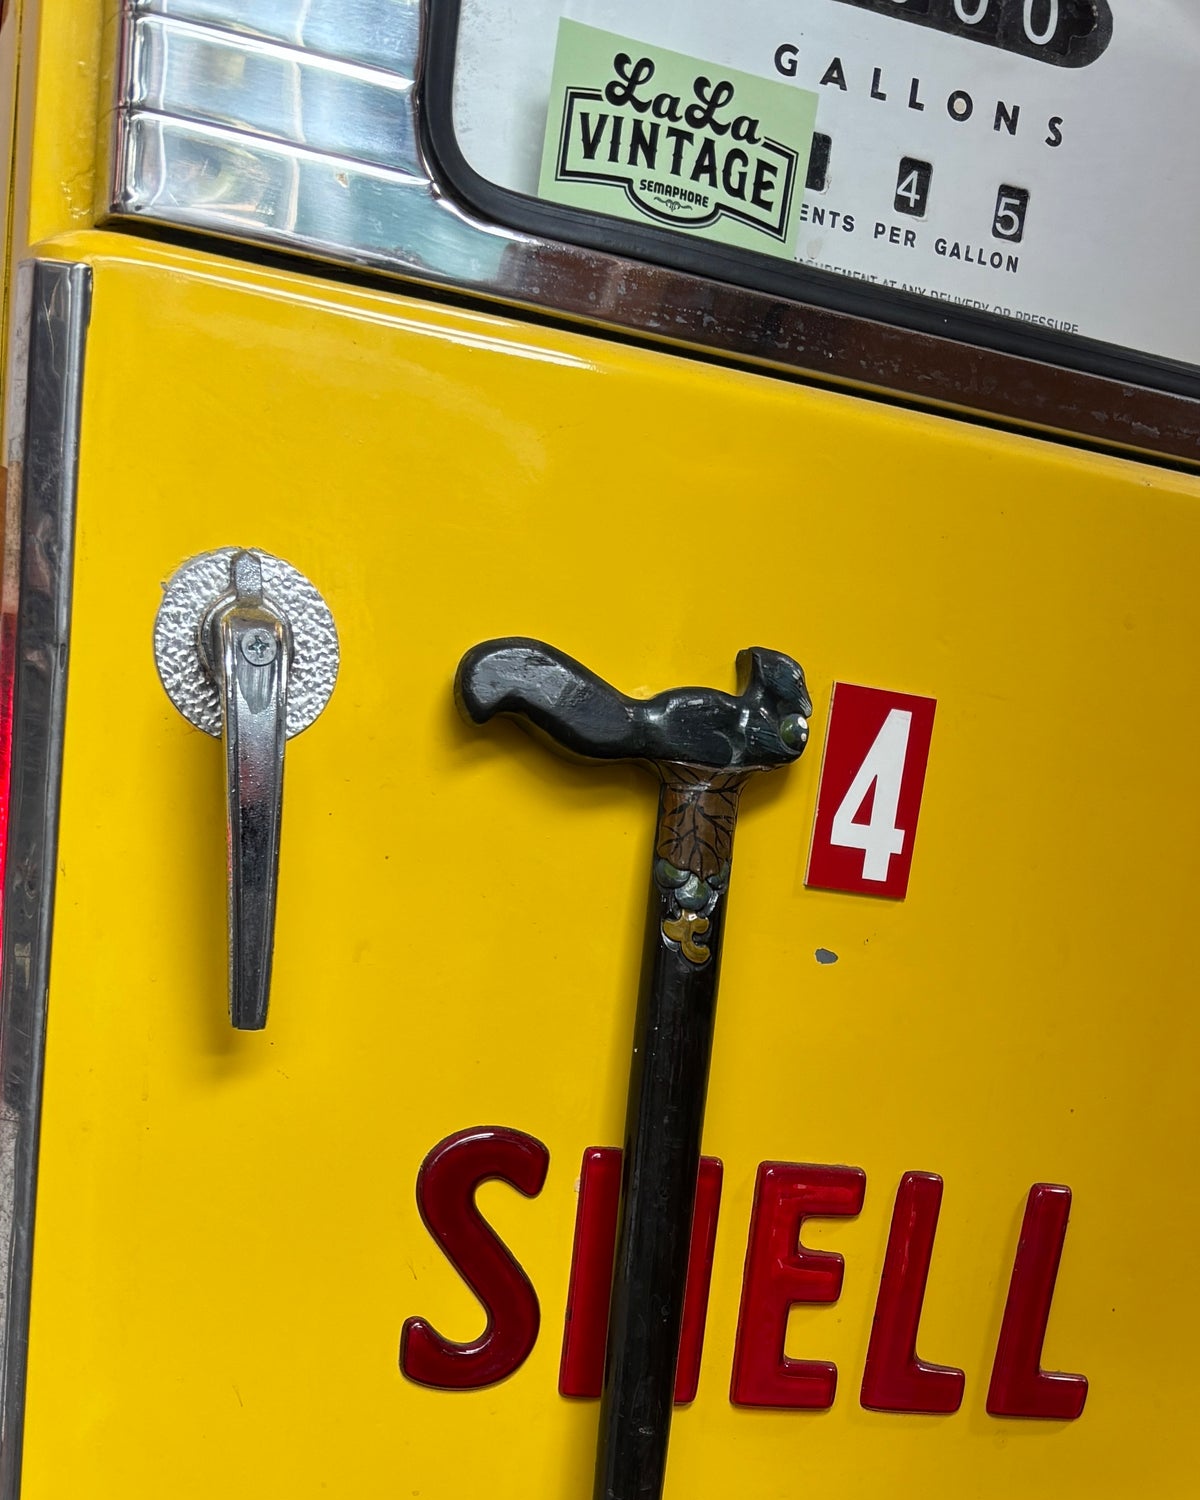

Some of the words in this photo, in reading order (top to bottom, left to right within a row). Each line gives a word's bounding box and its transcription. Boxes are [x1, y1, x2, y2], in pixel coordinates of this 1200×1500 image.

[774, 43, 1064, 147] GALLONS
[579, 111, 778, 213] VINTAGE
[639, 179, 709, 208] SEMAPHORE
[800, 204, 855, 232] ENTS
[873, 222, 917, 248] PER
[934, 238, 1020, 273] GALLON
[830, 708, 912, 882] 4
